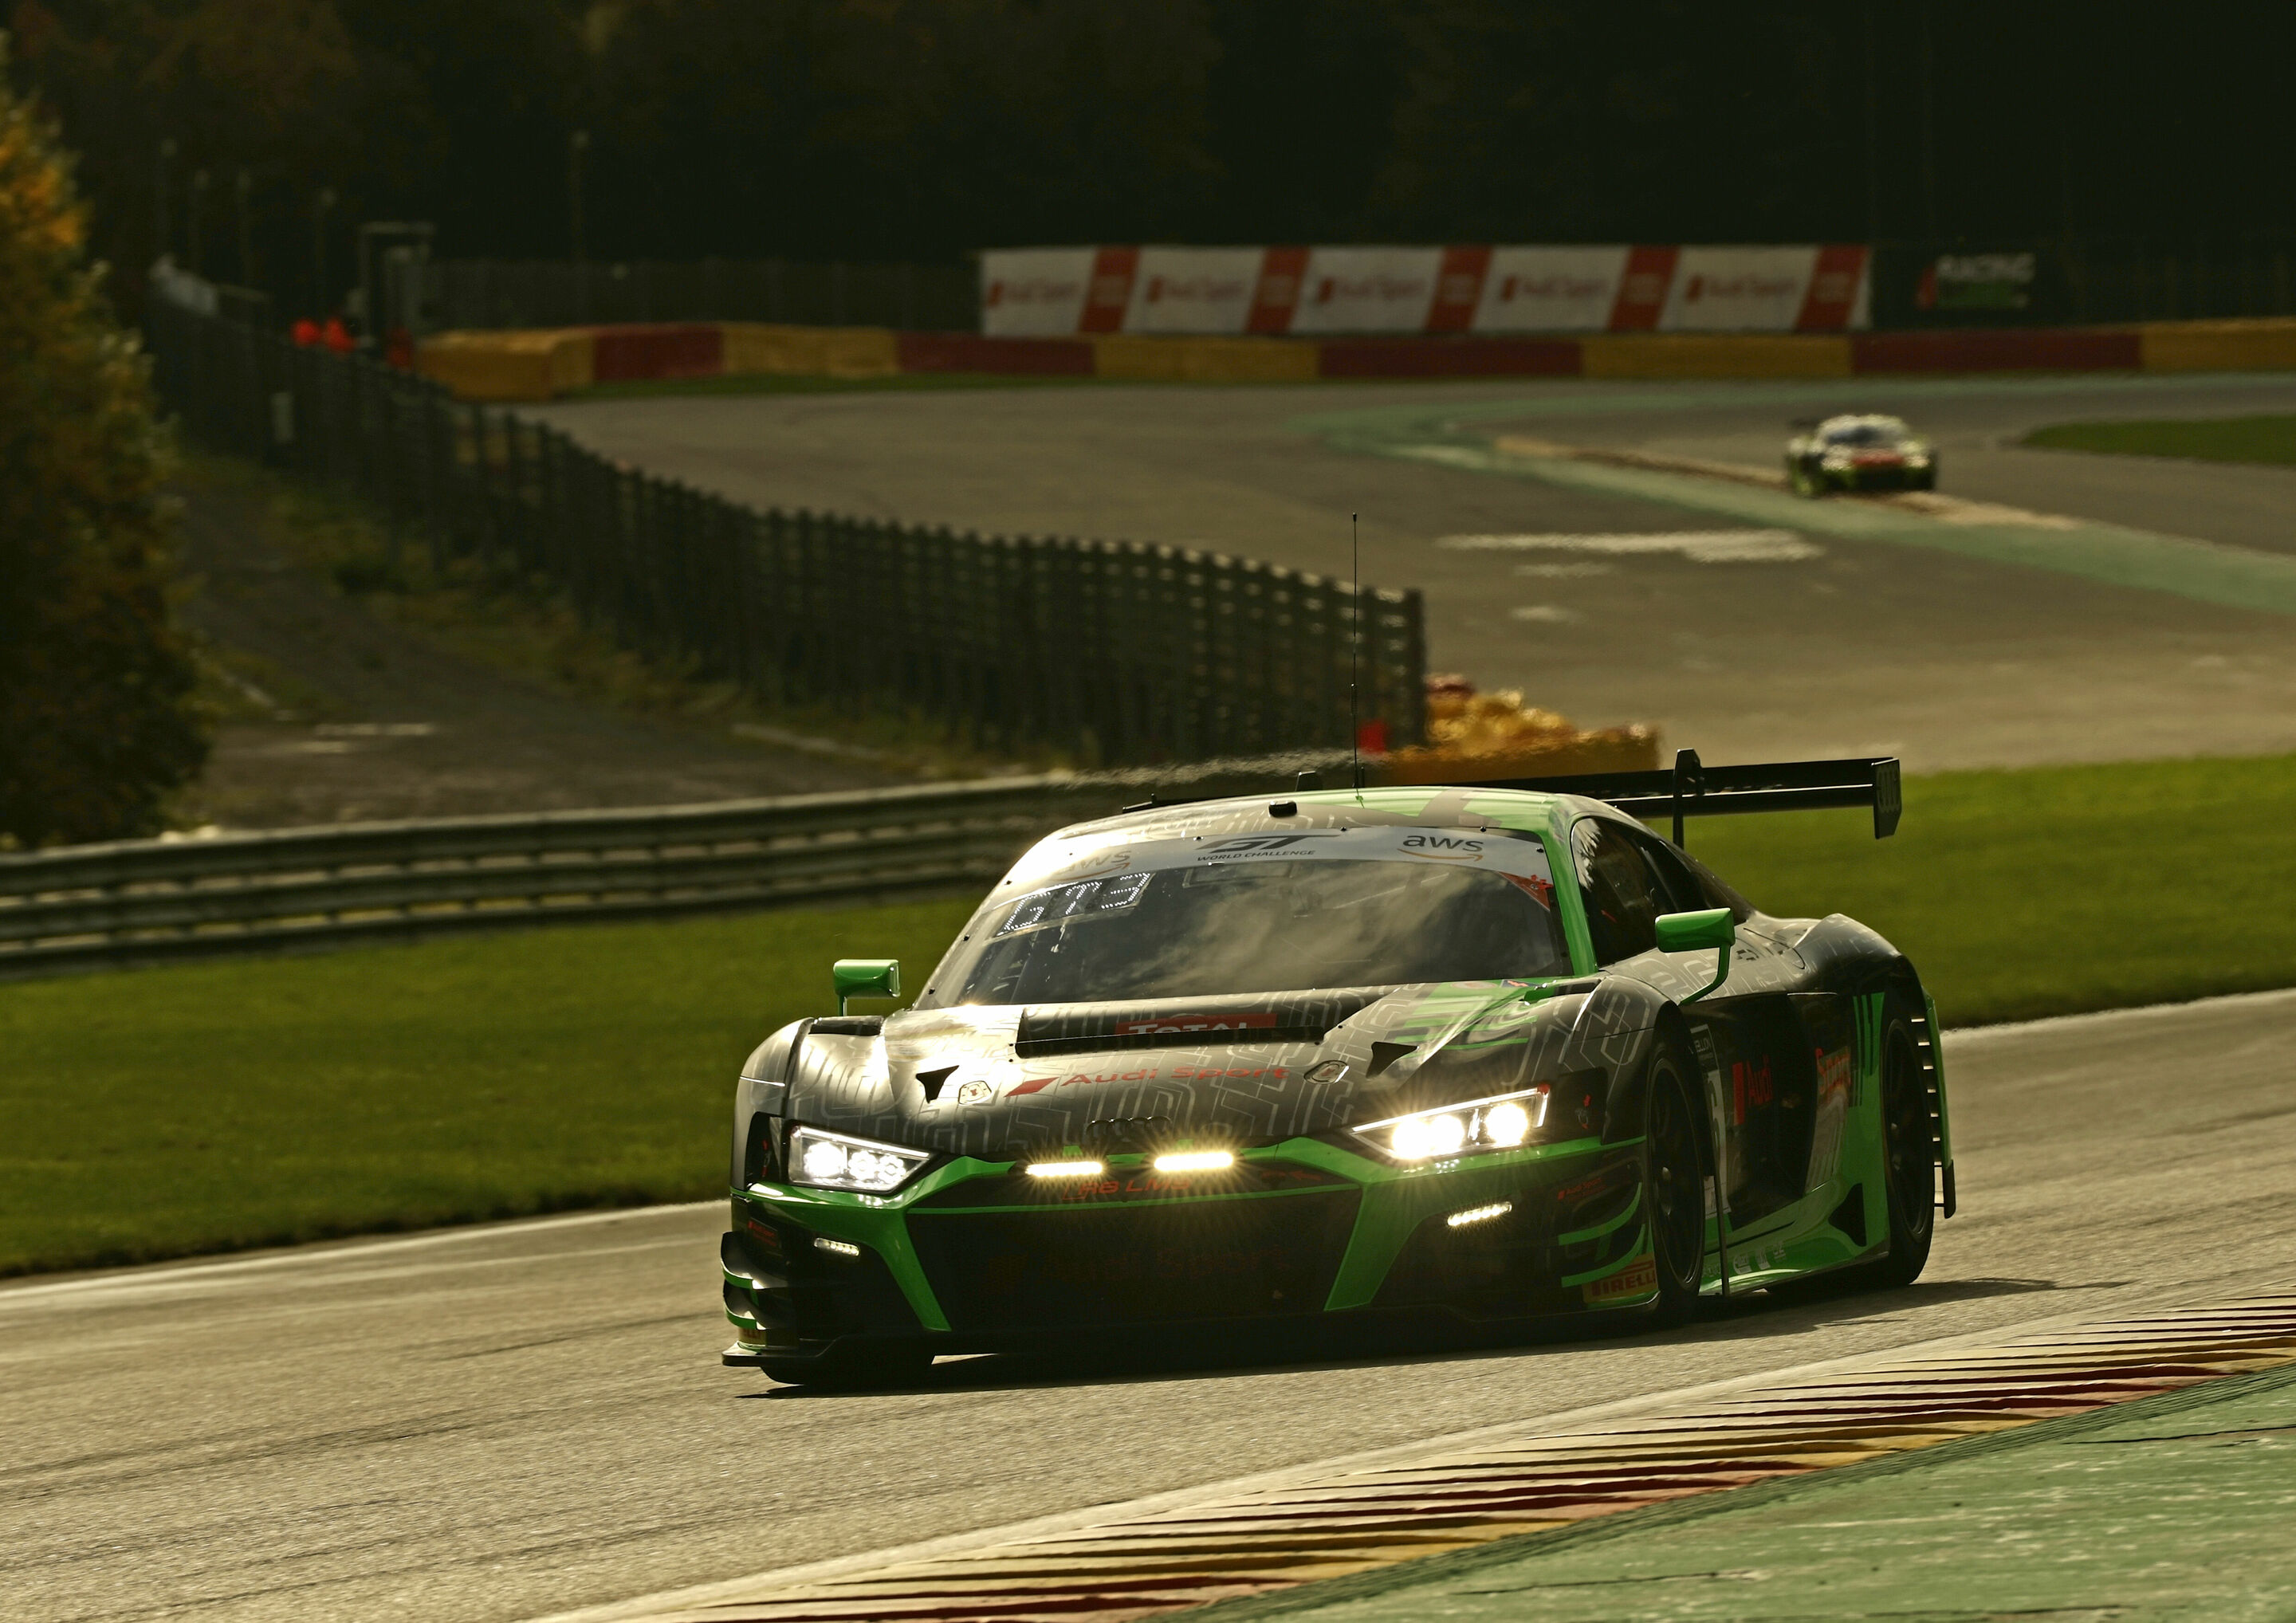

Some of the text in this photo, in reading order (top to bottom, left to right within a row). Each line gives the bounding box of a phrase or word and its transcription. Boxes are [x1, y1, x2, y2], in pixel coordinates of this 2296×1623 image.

[1403, 835, 1484, 851] aws
[1060, 1065, 1291, 1087] Audi Sport
[1126, 1177, 1191, 1193] LMS
